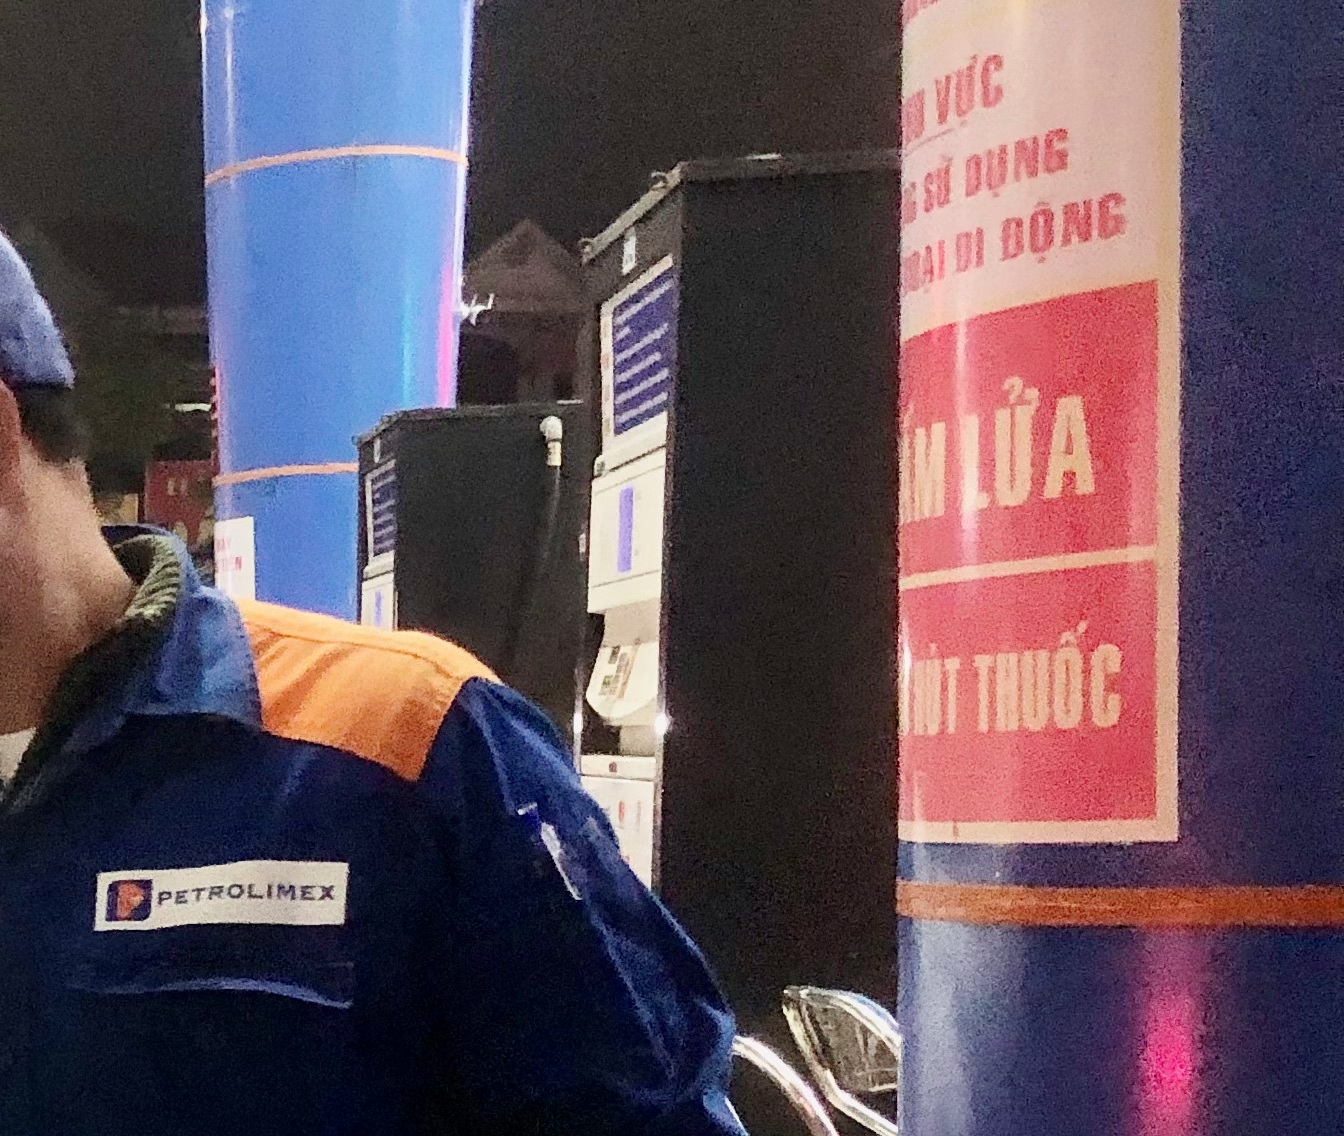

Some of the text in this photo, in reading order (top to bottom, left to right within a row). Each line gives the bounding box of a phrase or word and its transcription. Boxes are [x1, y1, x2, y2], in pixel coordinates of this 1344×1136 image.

[935, 54, 1003, 127] VỰC
[965, 128, 1069, 197] DỤNG
[955, 227, 984, 273] DI
[1000, 192, 1127, 263] ĐỘNG
[959, 376, 1096, 517] LỬA
[973, 619, 1123, 734] THUỐC
[158, 883, 335, 905] PETROLIMEX
